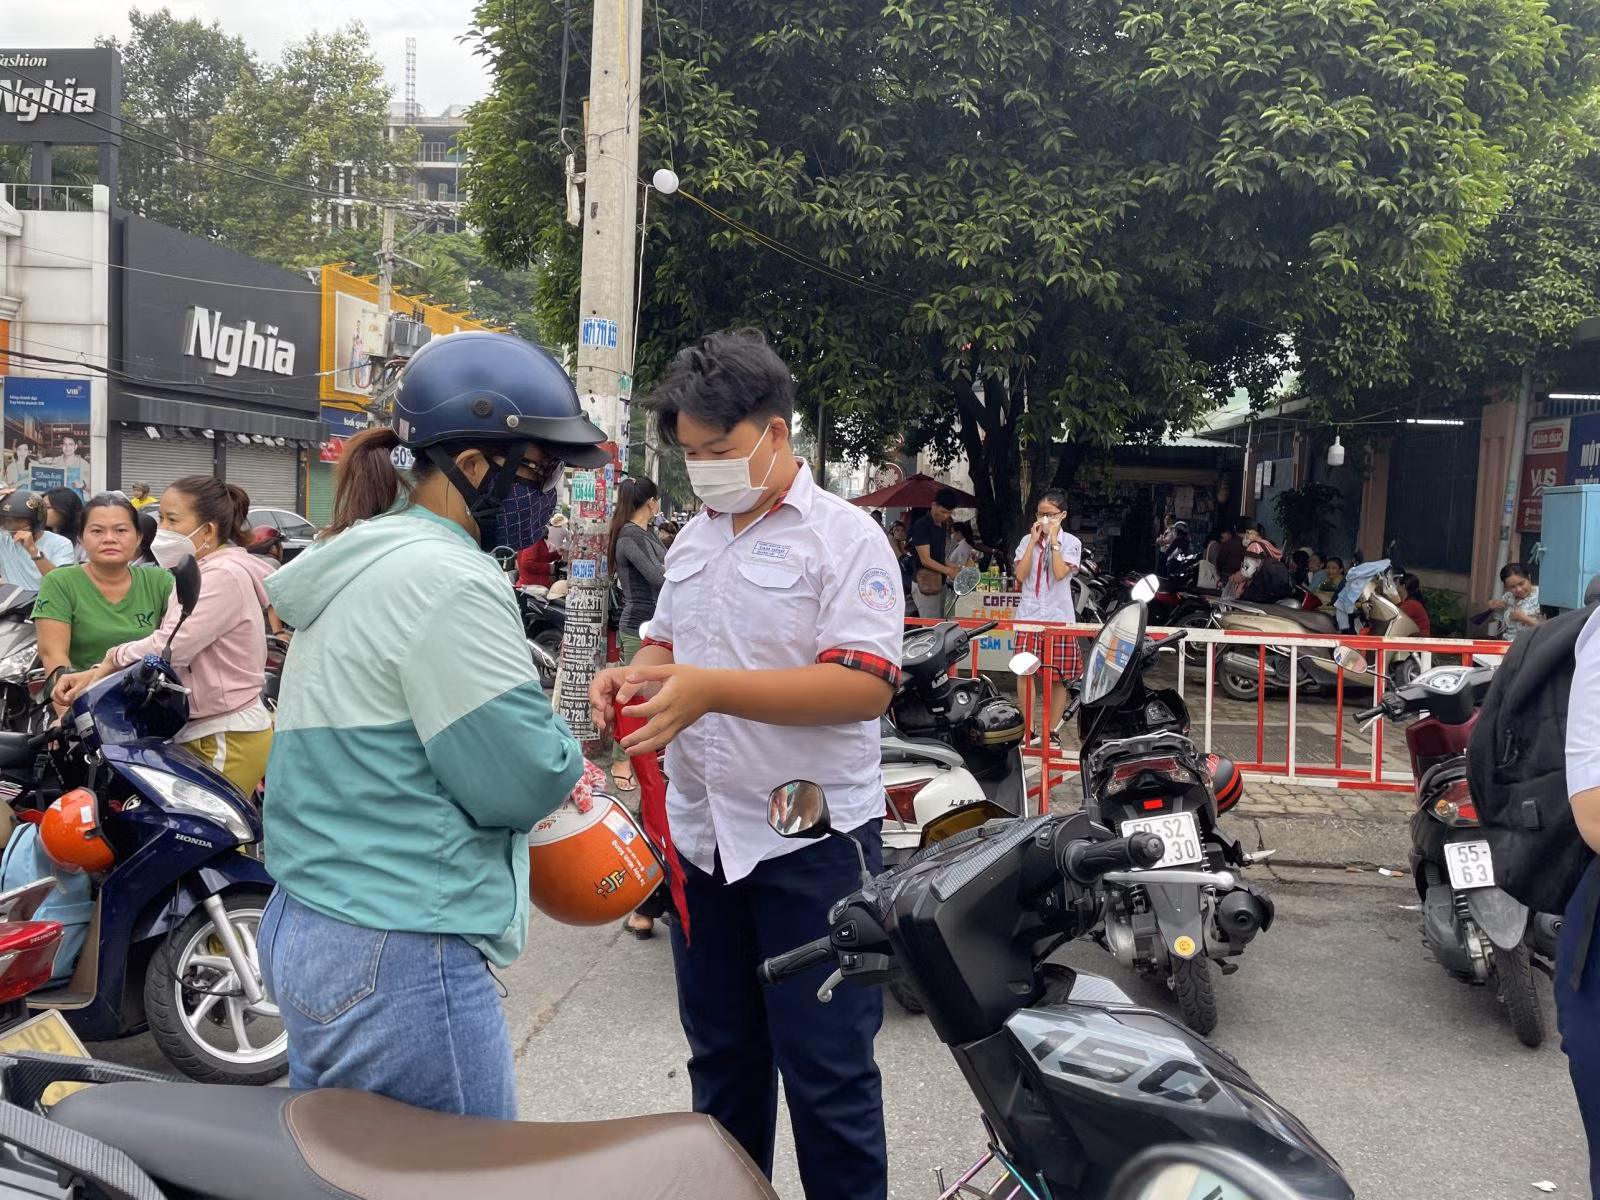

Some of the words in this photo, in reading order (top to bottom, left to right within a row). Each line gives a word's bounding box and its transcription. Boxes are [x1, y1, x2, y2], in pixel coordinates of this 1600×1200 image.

[0, 78, 96, 122] Nghĩa
[185, 306, 296, 377] Nghĩa
[1530, 467, 1557, 488] VUS
[983, 595, 1022, 608] COFFE
[948, 799, 982, 808] LE
[174, 833, 213, 849] HONDA
[1162, 839, 1196, 863] .30
